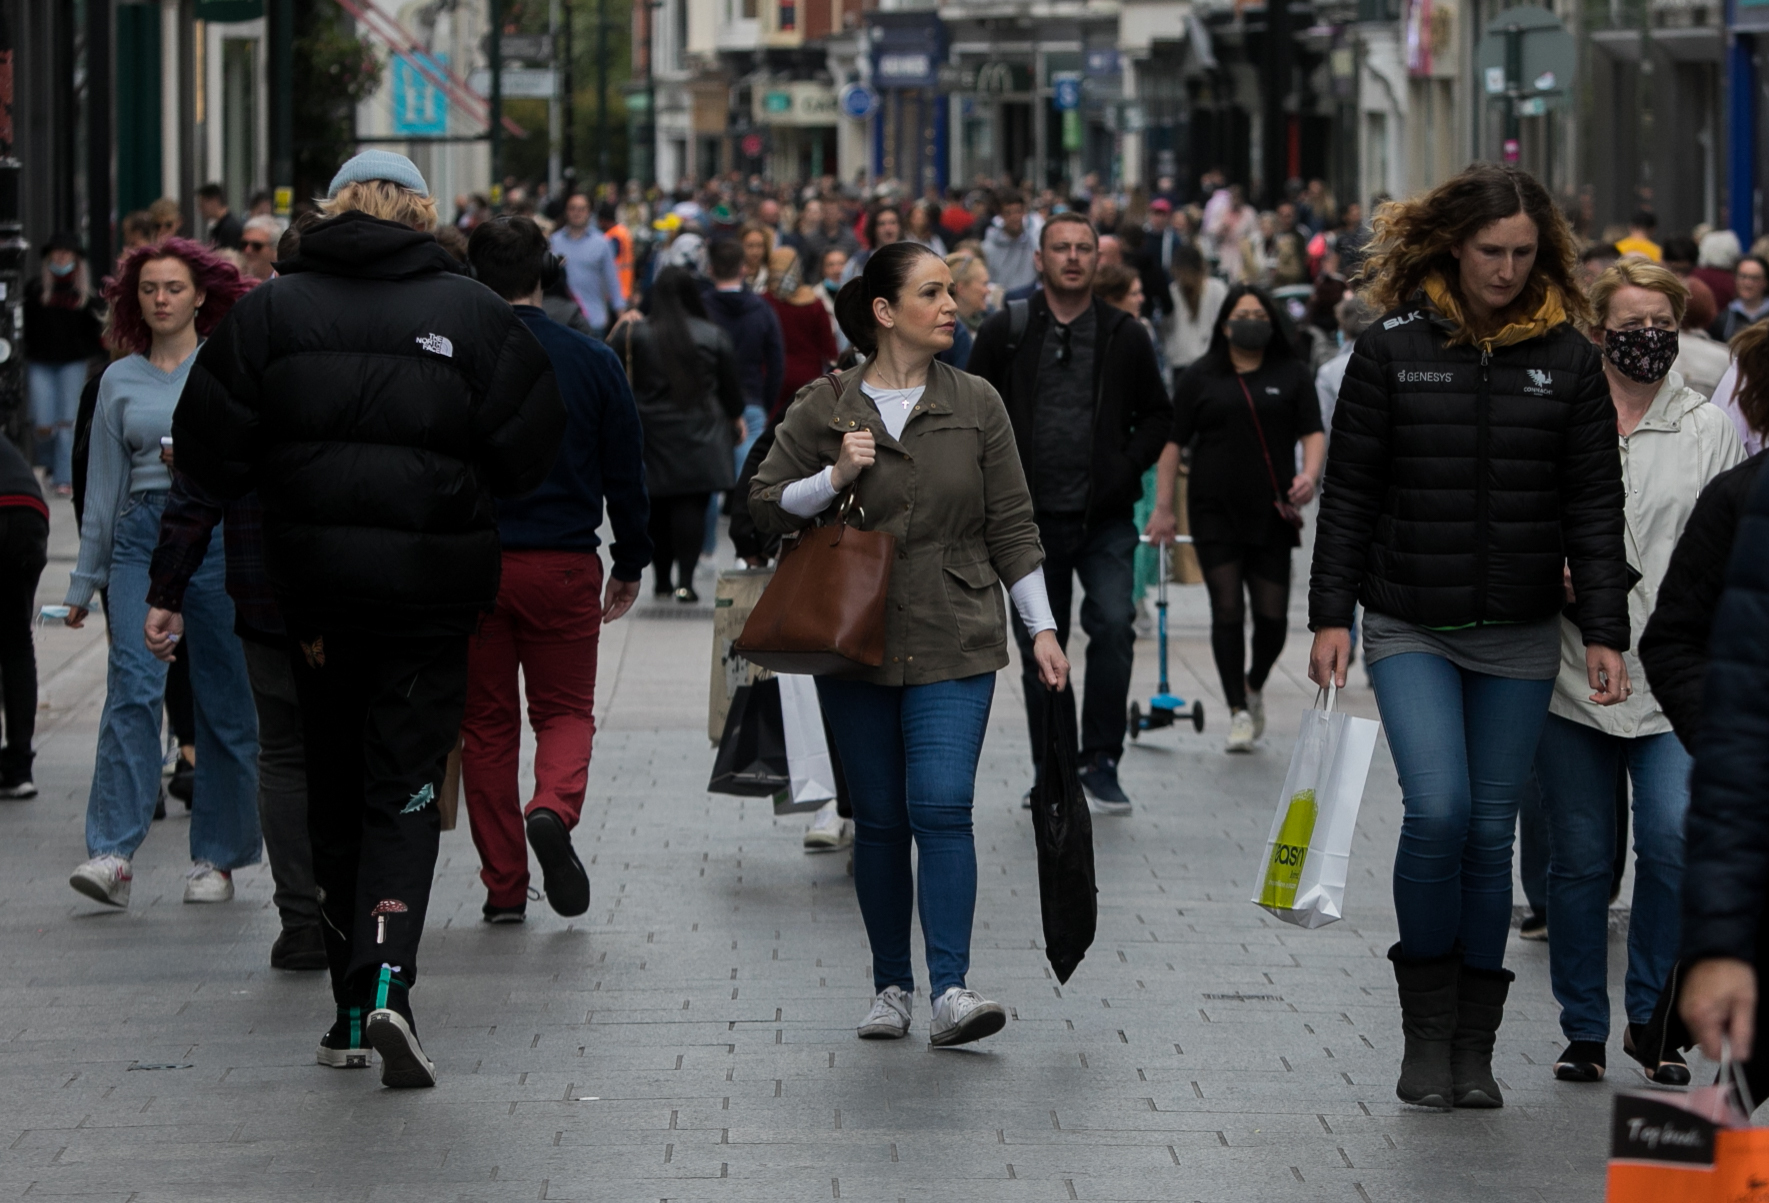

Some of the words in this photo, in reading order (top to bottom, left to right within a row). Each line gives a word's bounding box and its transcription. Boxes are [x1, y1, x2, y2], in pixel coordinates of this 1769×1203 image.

[1382, 310, 1424, 331] BLK
[415, 336, 442, 348] NORTH
[428, 332, 443, 343] THE
[422, 343, 442, 354] FACE
[1406, 371, 1453, 383] GENESYS
